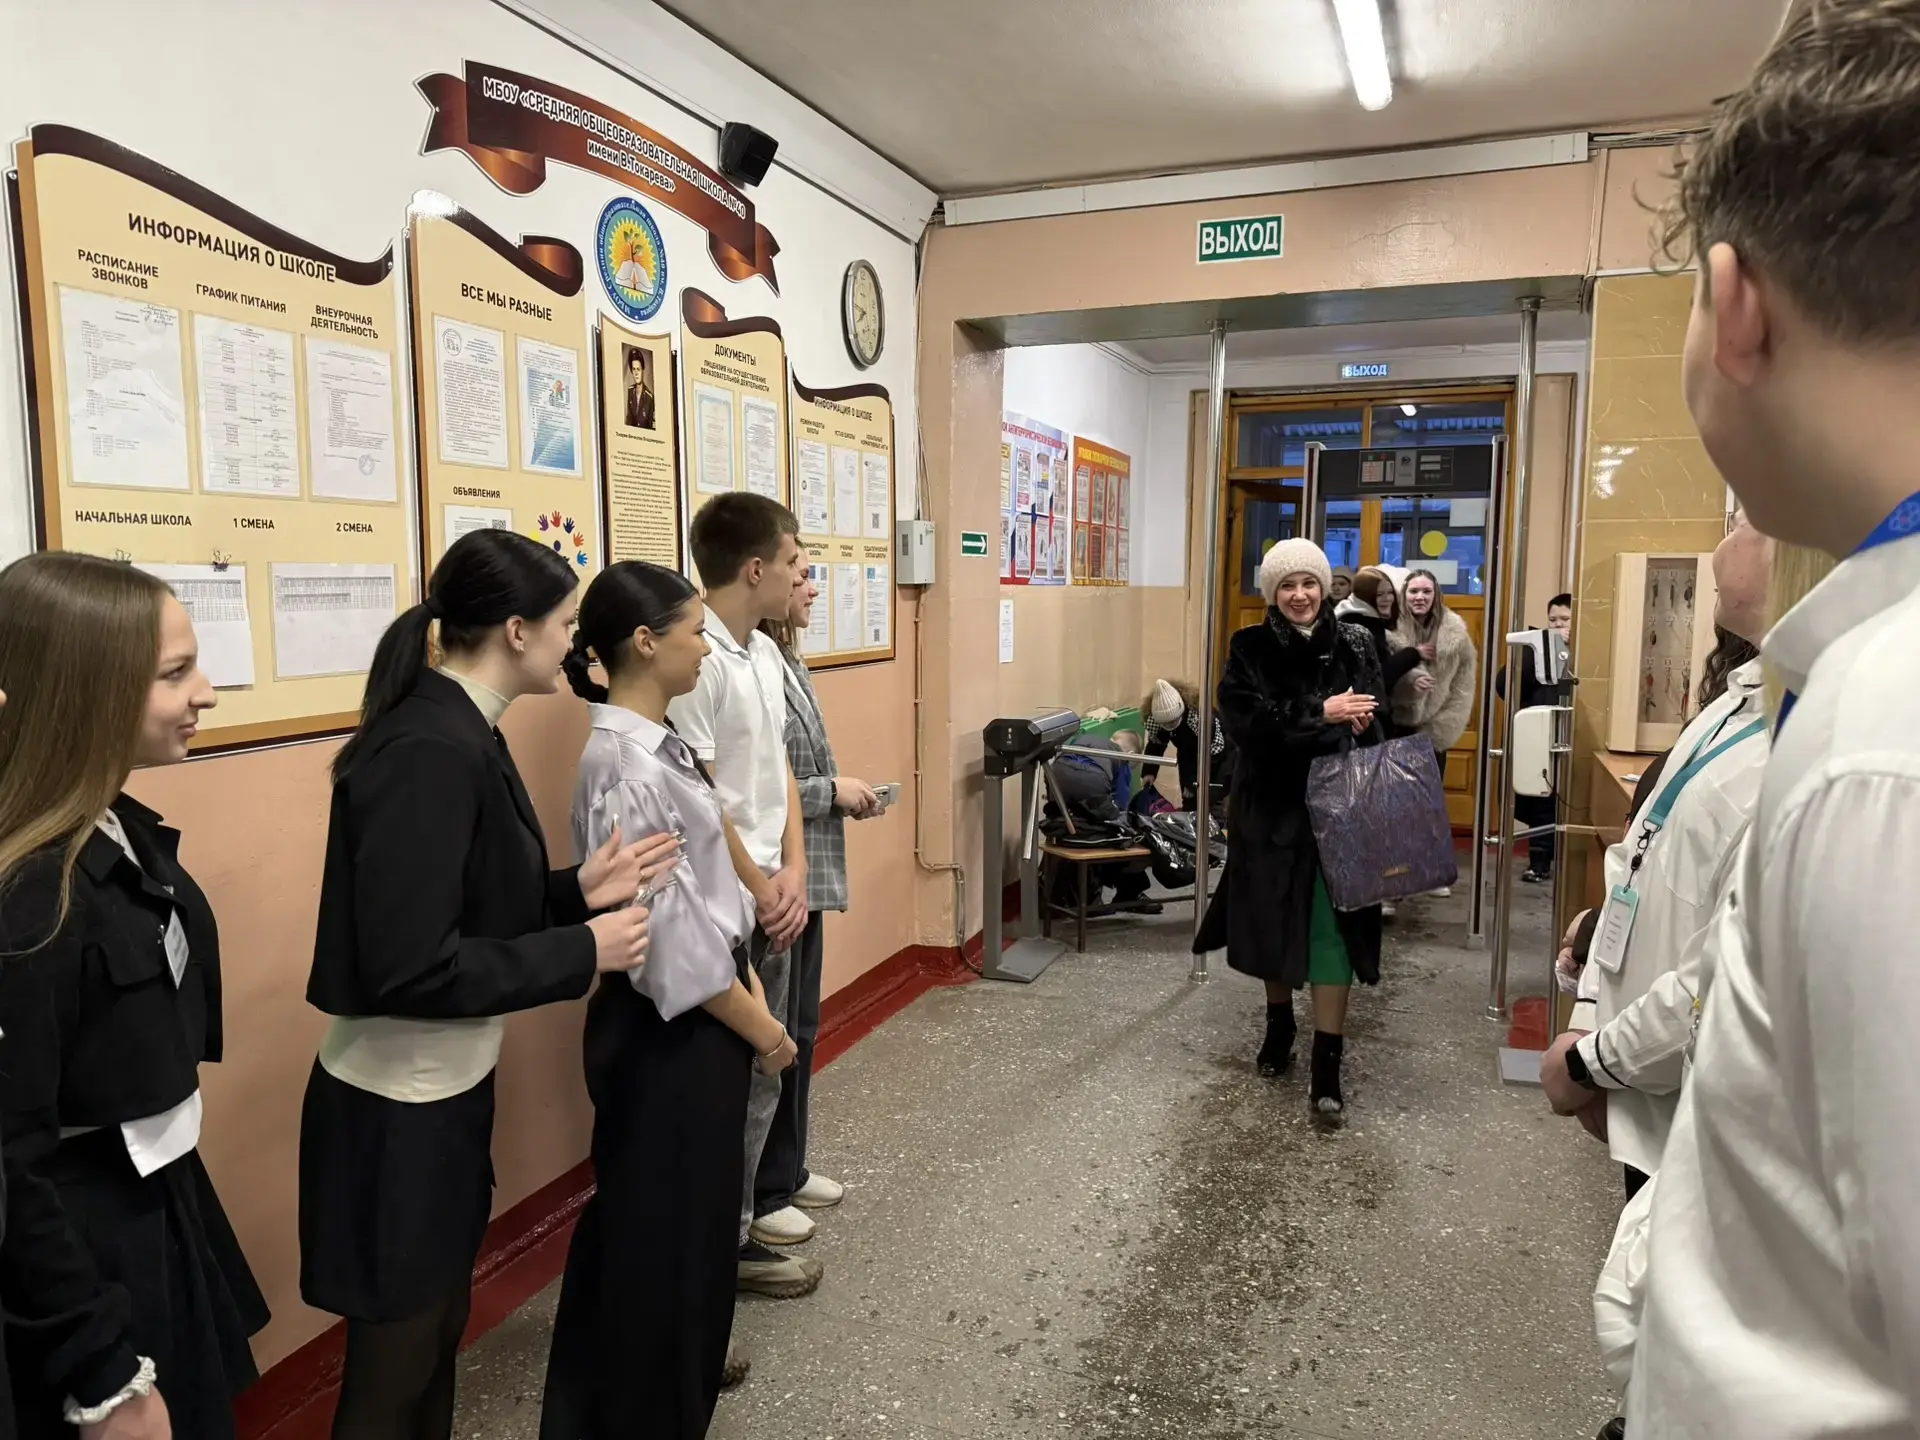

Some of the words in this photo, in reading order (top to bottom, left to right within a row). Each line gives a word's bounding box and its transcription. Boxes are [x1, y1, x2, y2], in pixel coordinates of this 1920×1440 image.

[483, 77, 518, 103] МБОУ
[520, 91, 580, 126] «СРЕДНЯЯ
[582, 111, 698, 185] ОБЩЕОБРАЗОВАТЕЛЬНАЯ
[699, 174, 729, 204] ШКОЛА
[728, 192, 746, 219] №40
[588, 140, 618, 162] имени
[620, 151, 675, 191] В.Токарева»
[128, 213, 260, 264] ИНФОРМАЦИЯ
[265, 250, 276, 267] О
[279, 254, 336, 283] ШКОЛЕ
[1201, 221, 1279, 256] ВЫХОД
[78, 249, 159, 278] РАСПИСАНИЕ
[91, 268, 149, 290] ЗВОНКОВ
[196, 284, 238, 303] ГРАФИК
[241, 292, 287, 314] ПИТАНИЯ
[461, 283, 484, 302] ВСЕ
[487, 290, 505, 308] МЫ
[509, 297, 552, 321] РАЗНЫЕ
[315, 305, 373, 326] ВНЕУРОЧНАЯ
[311, 317, 379, 339] ДЕЯТЕЛЬНОСТЬ
[715, 344, 756, 366] ДОКУМЕНТЫ
[1343, 364, 1387, 377] ВЫХОД
[453, 486, 501, 499] ОБЪЯВЛЕНИЯ
[75, 510, 148, 525] НАЧАЛЬНАЯ
[150, 513, 192, 527] ШКОЛА
[233, 518, 238, 528] 1
[241, 518, 275, 529] СМЕНА
[336, 522, 342, 533] 2
[343, 523, 373, 533] СМЕНА
